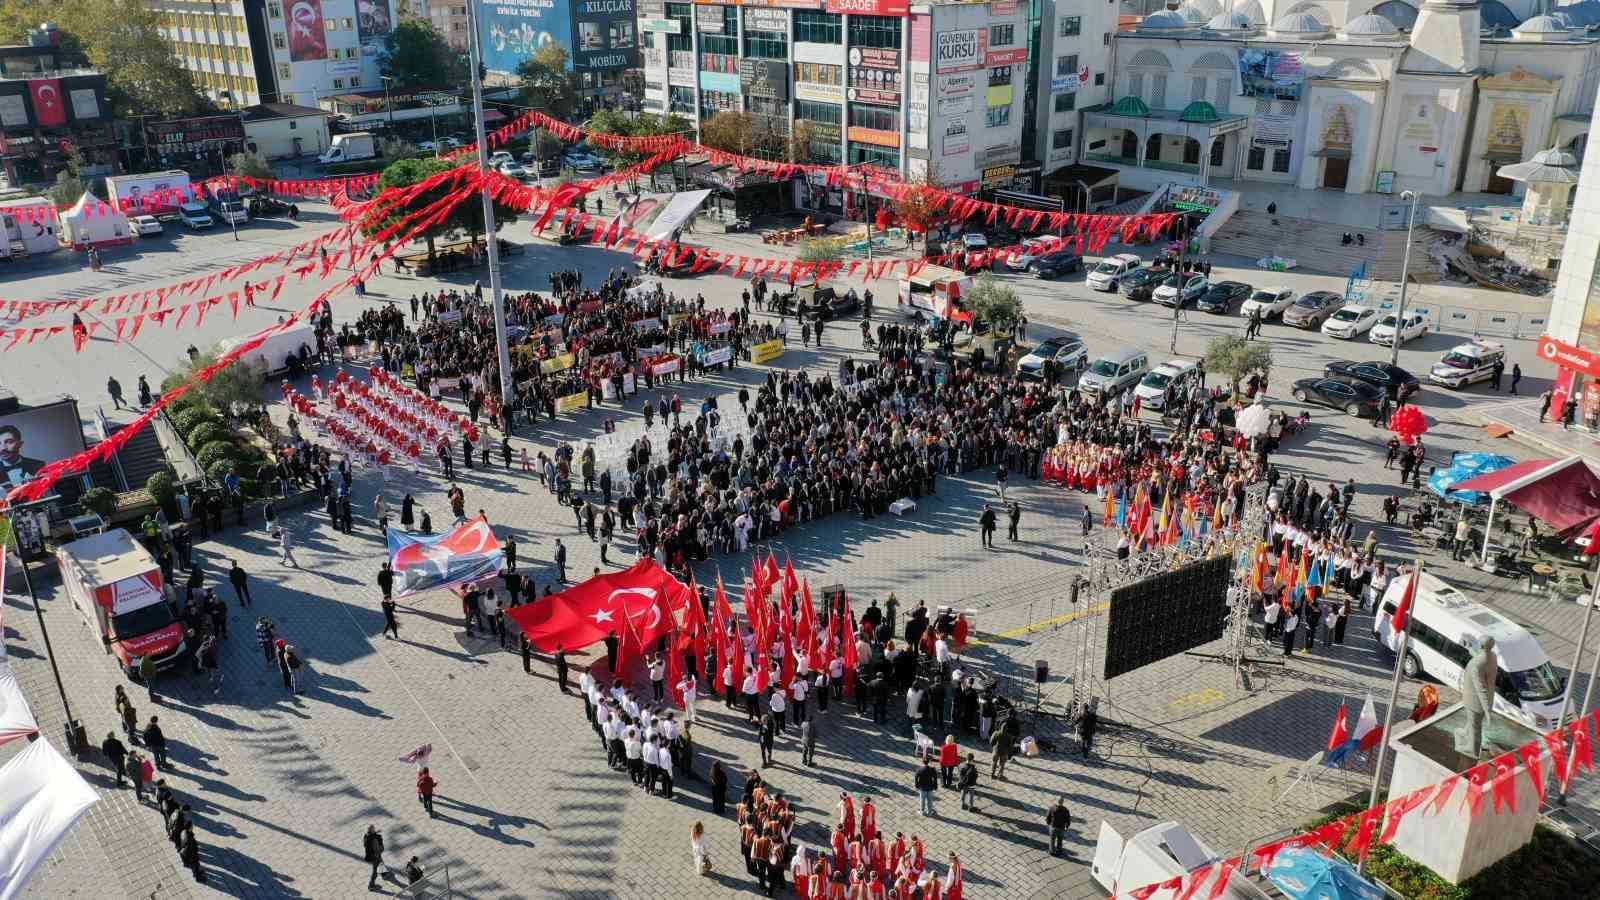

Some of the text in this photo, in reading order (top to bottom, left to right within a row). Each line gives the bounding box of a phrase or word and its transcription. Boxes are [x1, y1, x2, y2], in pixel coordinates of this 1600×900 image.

[587, 1, 632, 12] KILIÇLAR
[838, 0, 877, 11] SAADET
[939, 43, 976, 59] KURSU
[589, 54, 628, 67] MOBİLYA
